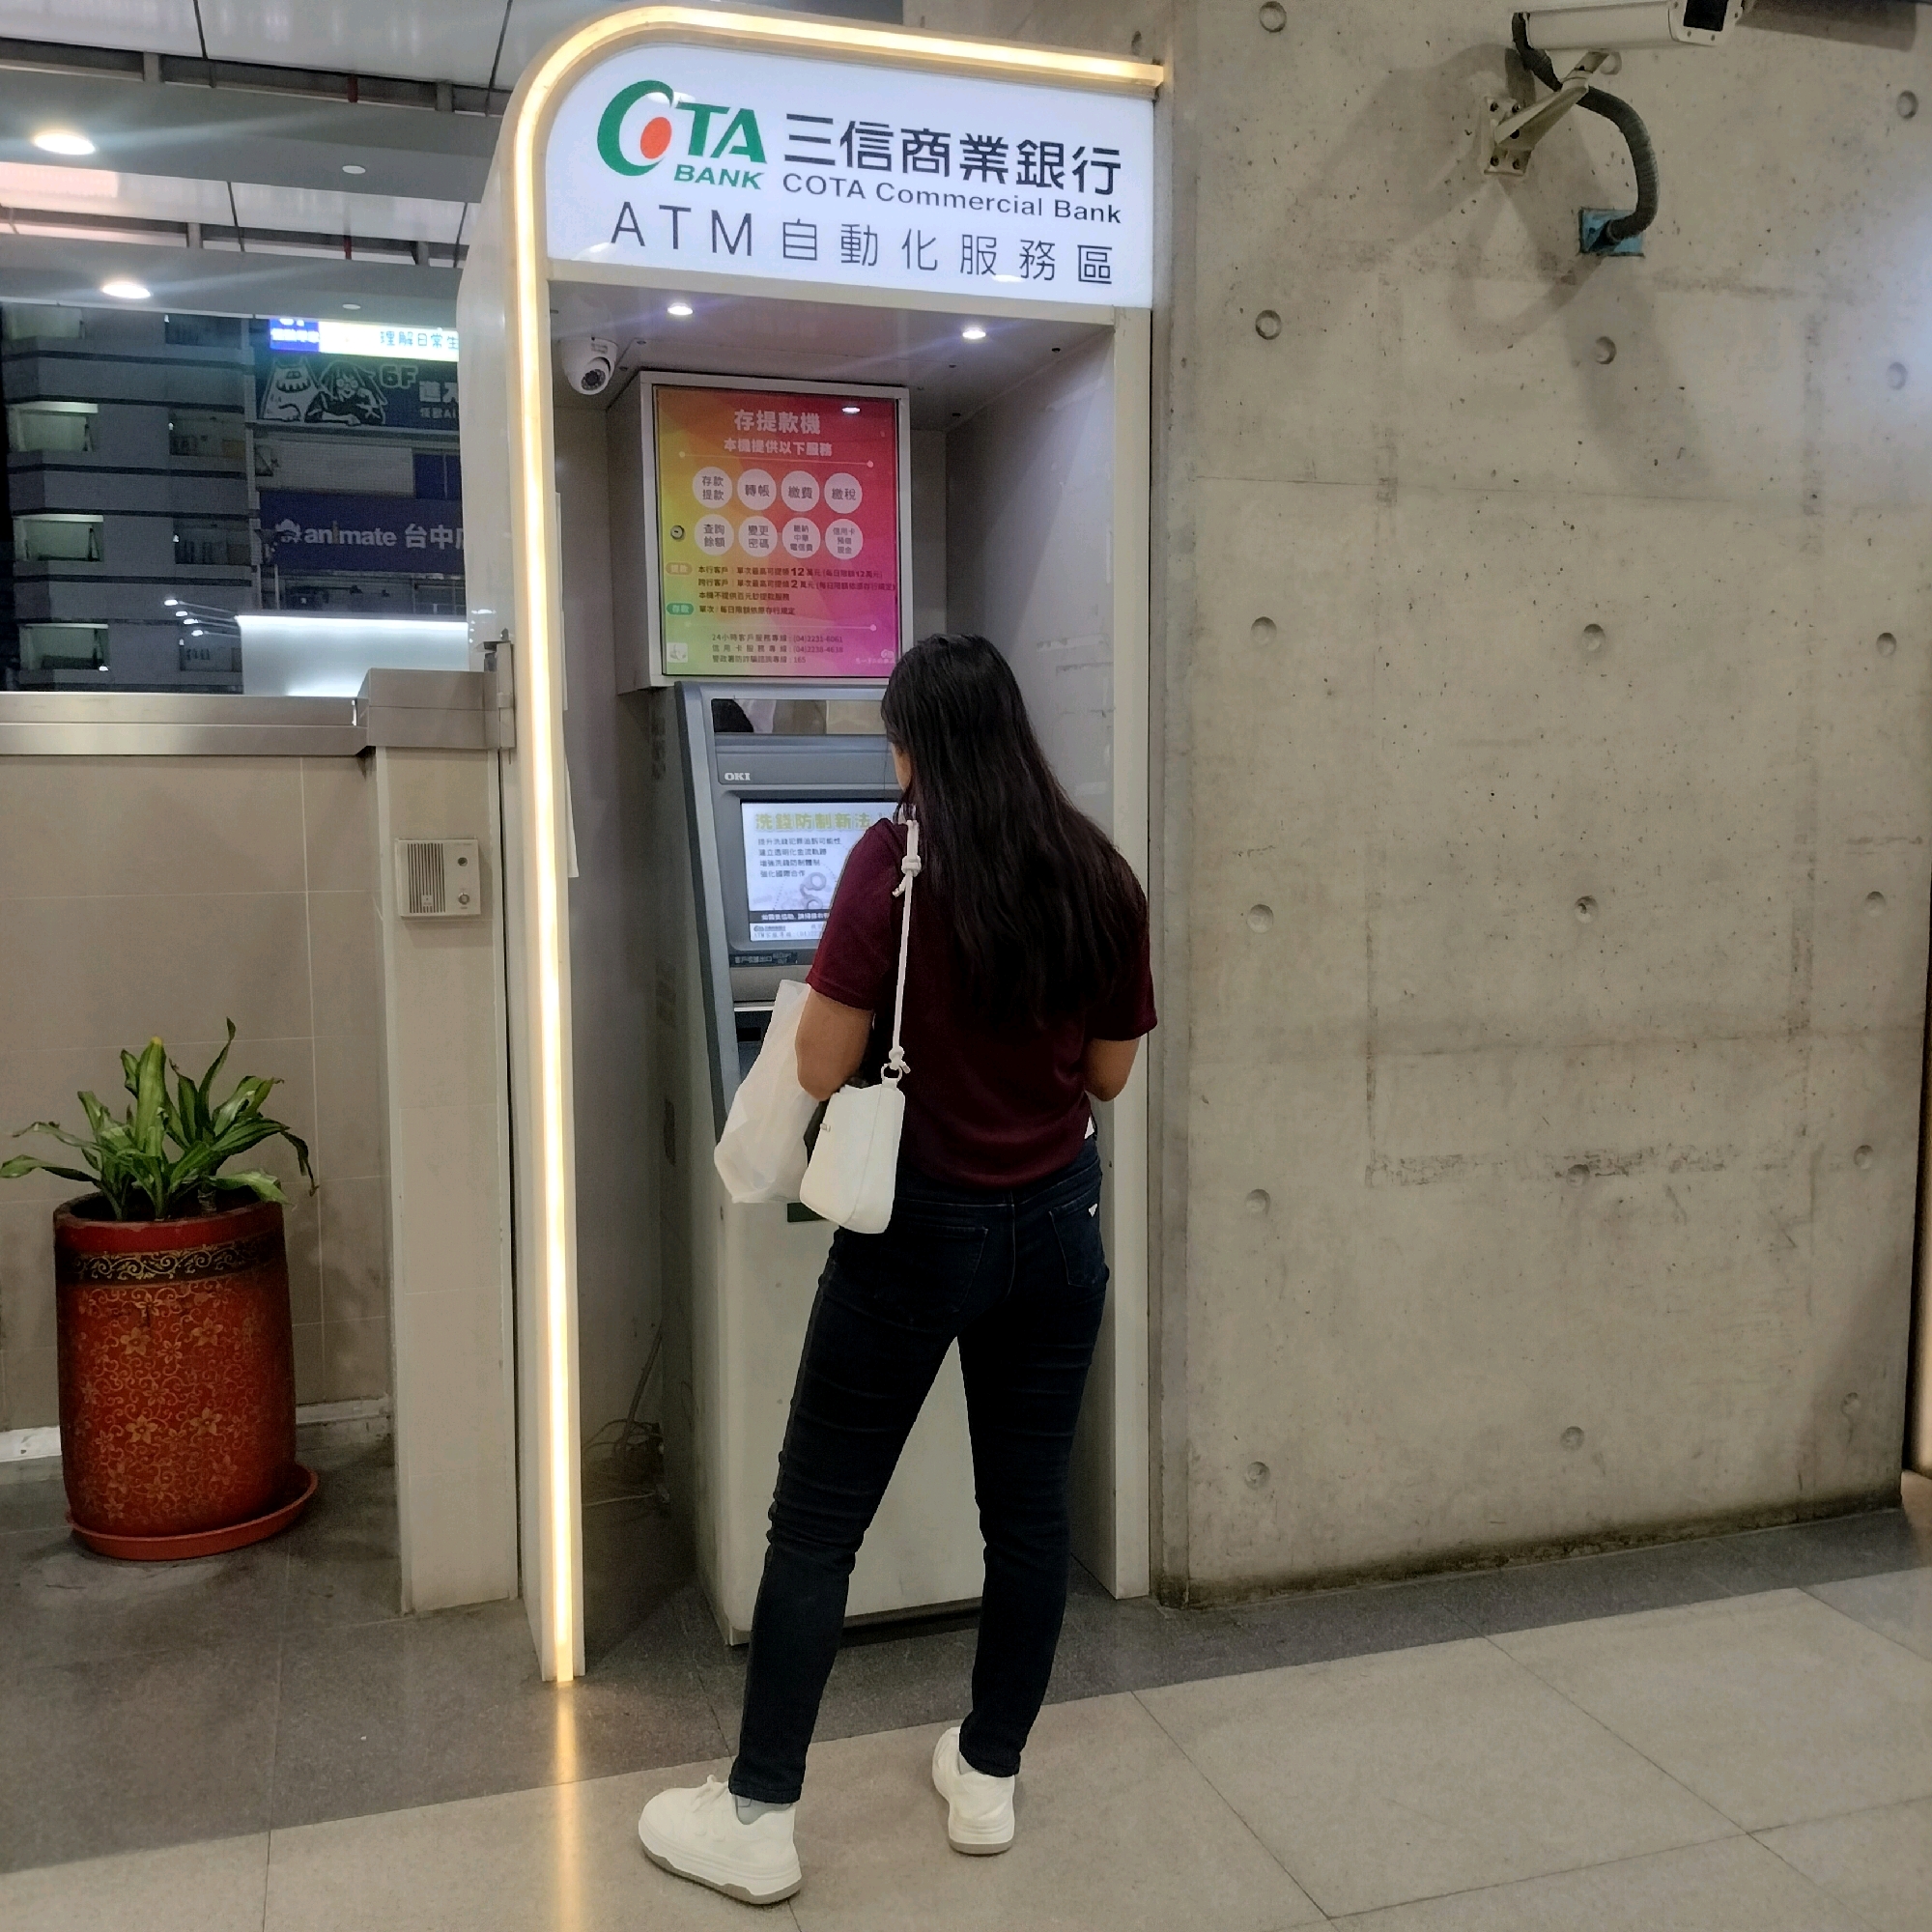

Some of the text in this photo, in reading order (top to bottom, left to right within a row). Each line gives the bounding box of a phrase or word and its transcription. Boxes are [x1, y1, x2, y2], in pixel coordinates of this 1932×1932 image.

[784, 113, 1122, 196] 三信商業銀行
[674, 164, 761, 190] BANK
[782, 173, 1122, 224] COTA Commercial Bank
[611, 201, 1113, 285] ATM 自動化服務區
[734, 409, 821, 435] 存提款機
[724, 438, 832, 457] 本機提供以下服務
[701, 475, 724, 487] 存款
[745, 484, 770, 497] 轉帳
[702, 489, 724, 500] 提款
[787, 486, 813, 499] 繳費
[304, 521, 397, 547] animate
[724, 772, 751, 781] OKI
